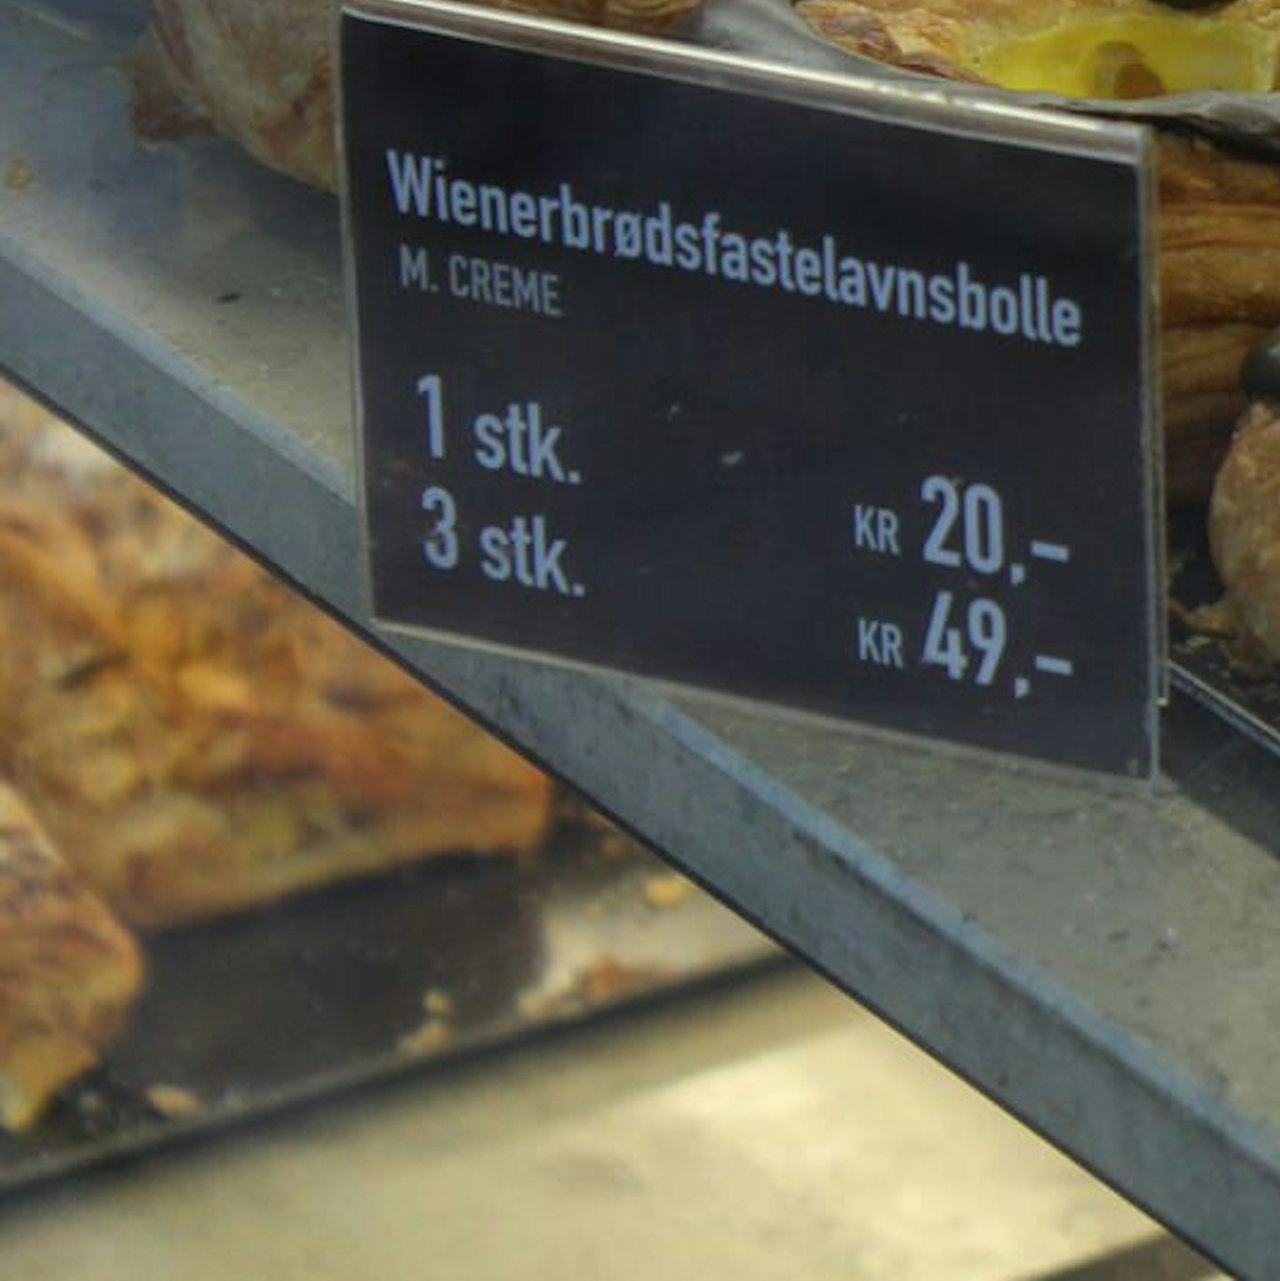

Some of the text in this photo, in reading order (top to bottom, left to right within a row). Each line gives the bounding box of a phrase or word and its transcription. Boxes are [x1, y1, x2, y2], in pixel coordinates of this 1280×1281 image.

[385, 148, 1083, 349] Wienerbrødsfastelavnsbolle
[398, 244, 562, 317] M. CREME
[416, 373, 1071, 587] 1 stk. KR 20,-
[420, 485, 1074, 699] 3 stk. KR 49,-
